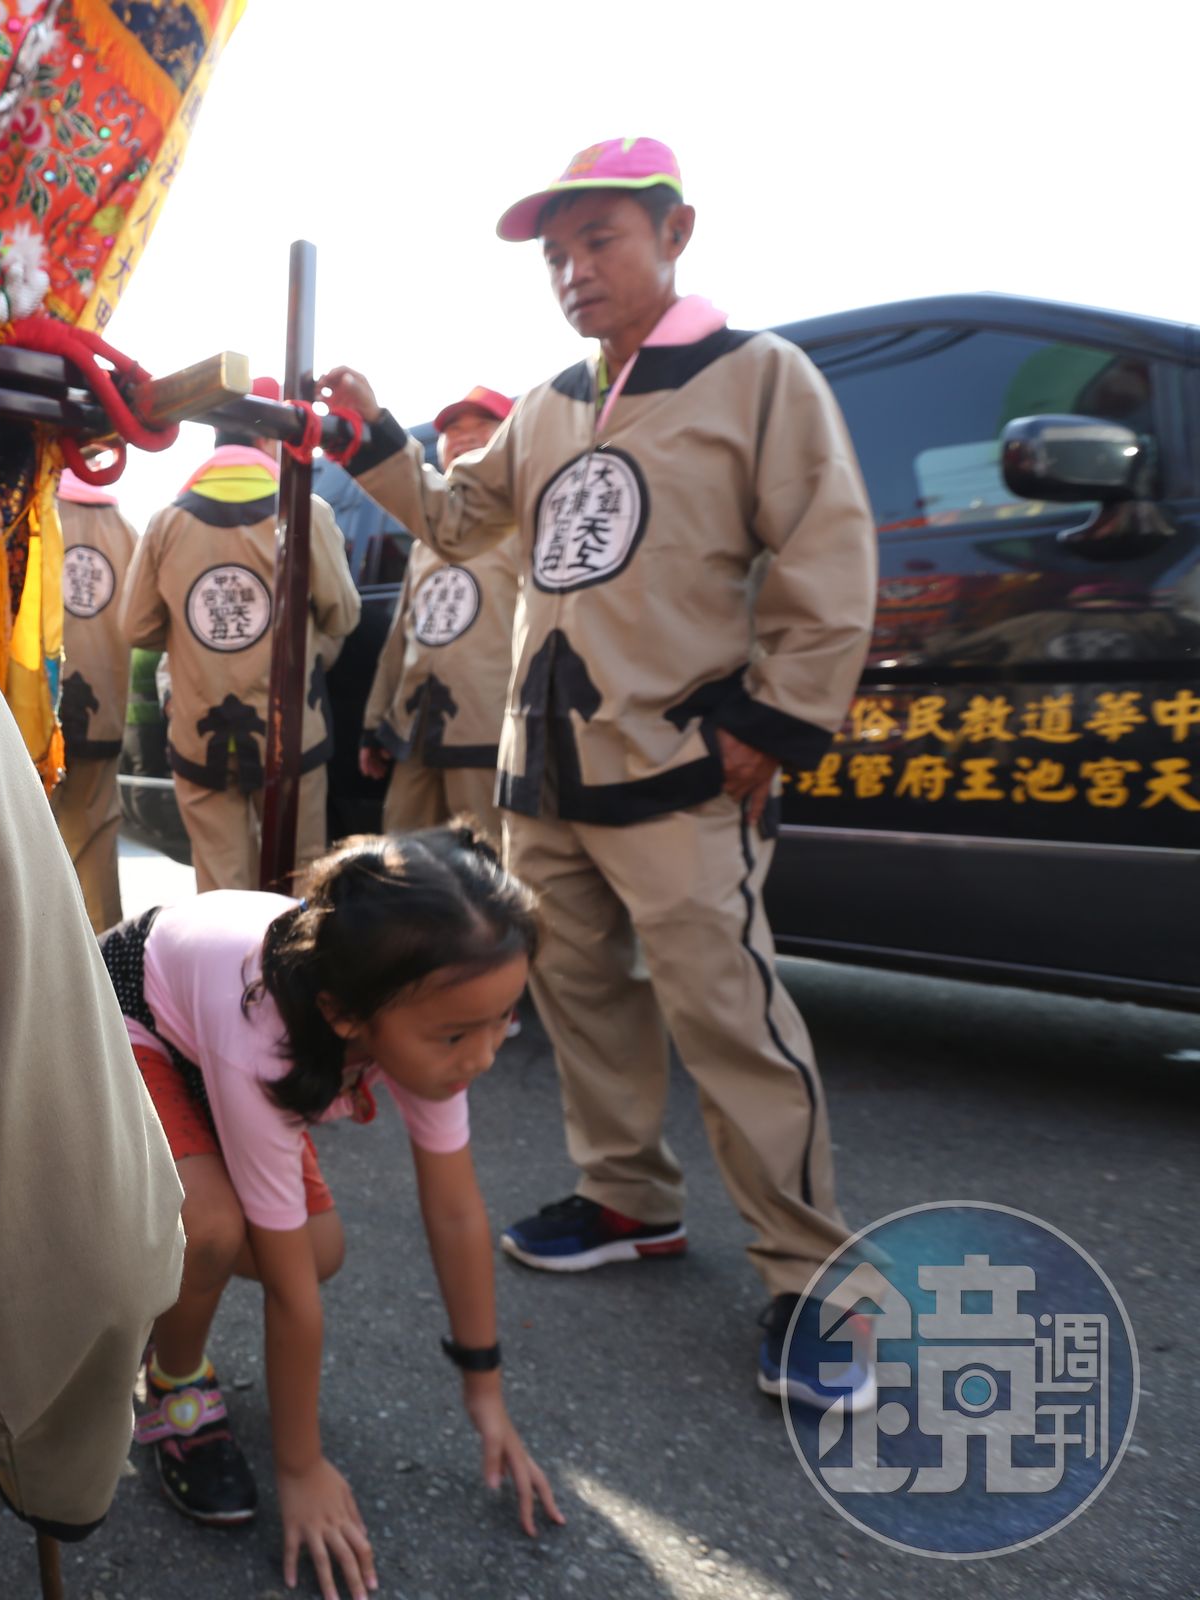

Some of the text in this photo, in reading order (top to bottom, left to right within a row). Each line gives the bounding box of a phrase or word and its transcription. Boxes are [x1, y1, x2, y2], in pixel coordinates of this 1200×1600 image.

[833, 689, 1200, 742] 中華道教民俗
[780, 752, 1200, 812] 天宮池王府管理
